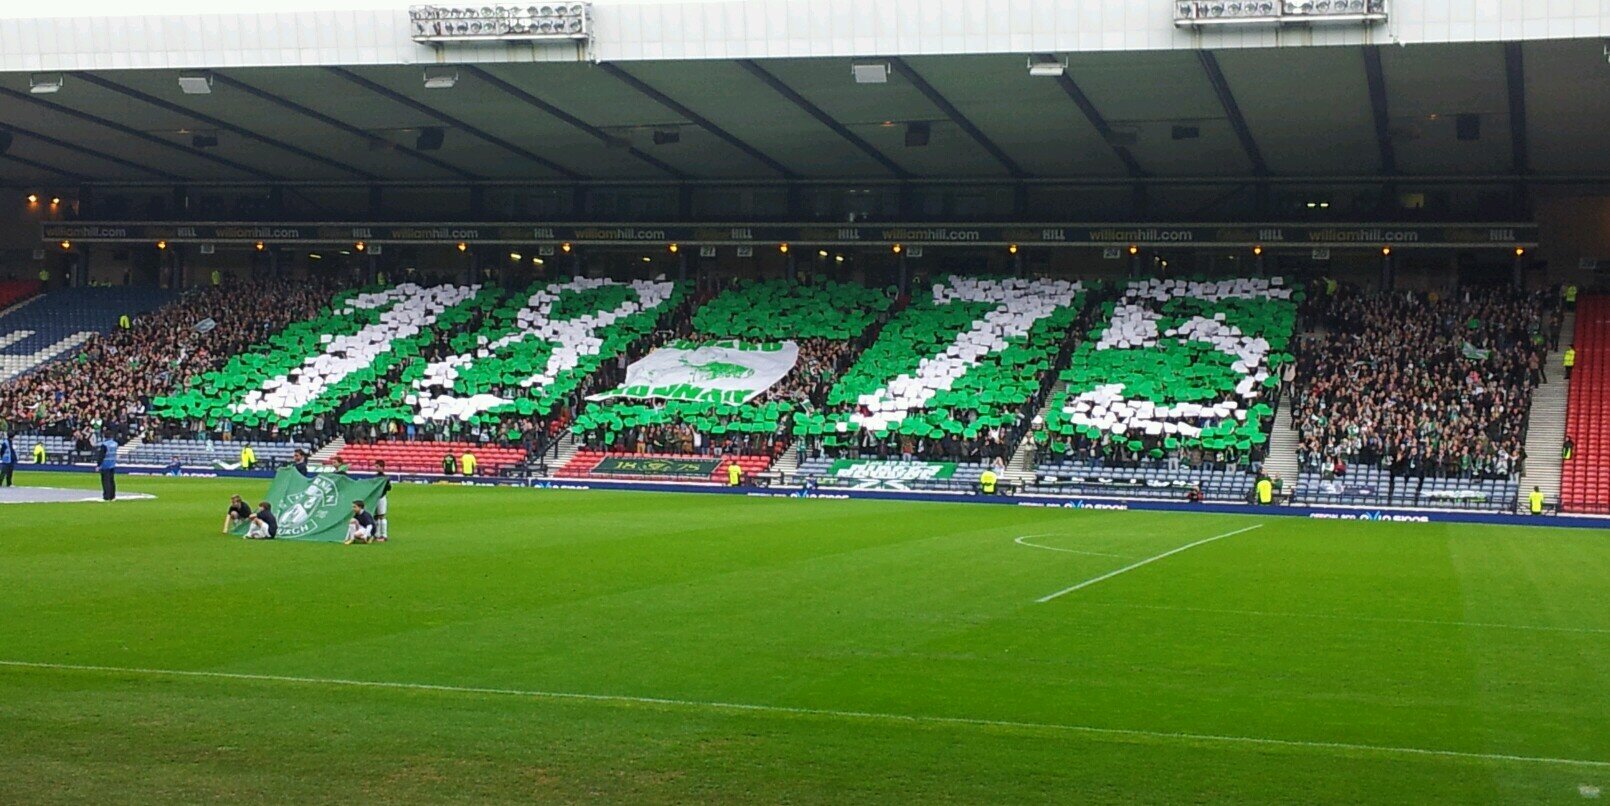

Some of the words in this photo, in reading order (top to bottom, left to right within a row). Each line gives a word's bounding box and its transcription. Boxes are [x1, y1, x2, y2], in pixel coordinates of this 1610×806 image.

[575, 228, 665, 240] williamhill.com
[882, 229, 979, 240] williamhill.com
[1089, 229, 1192, 240] williamhill.com
[1309, 229, 1418, 241] williamhill.com
